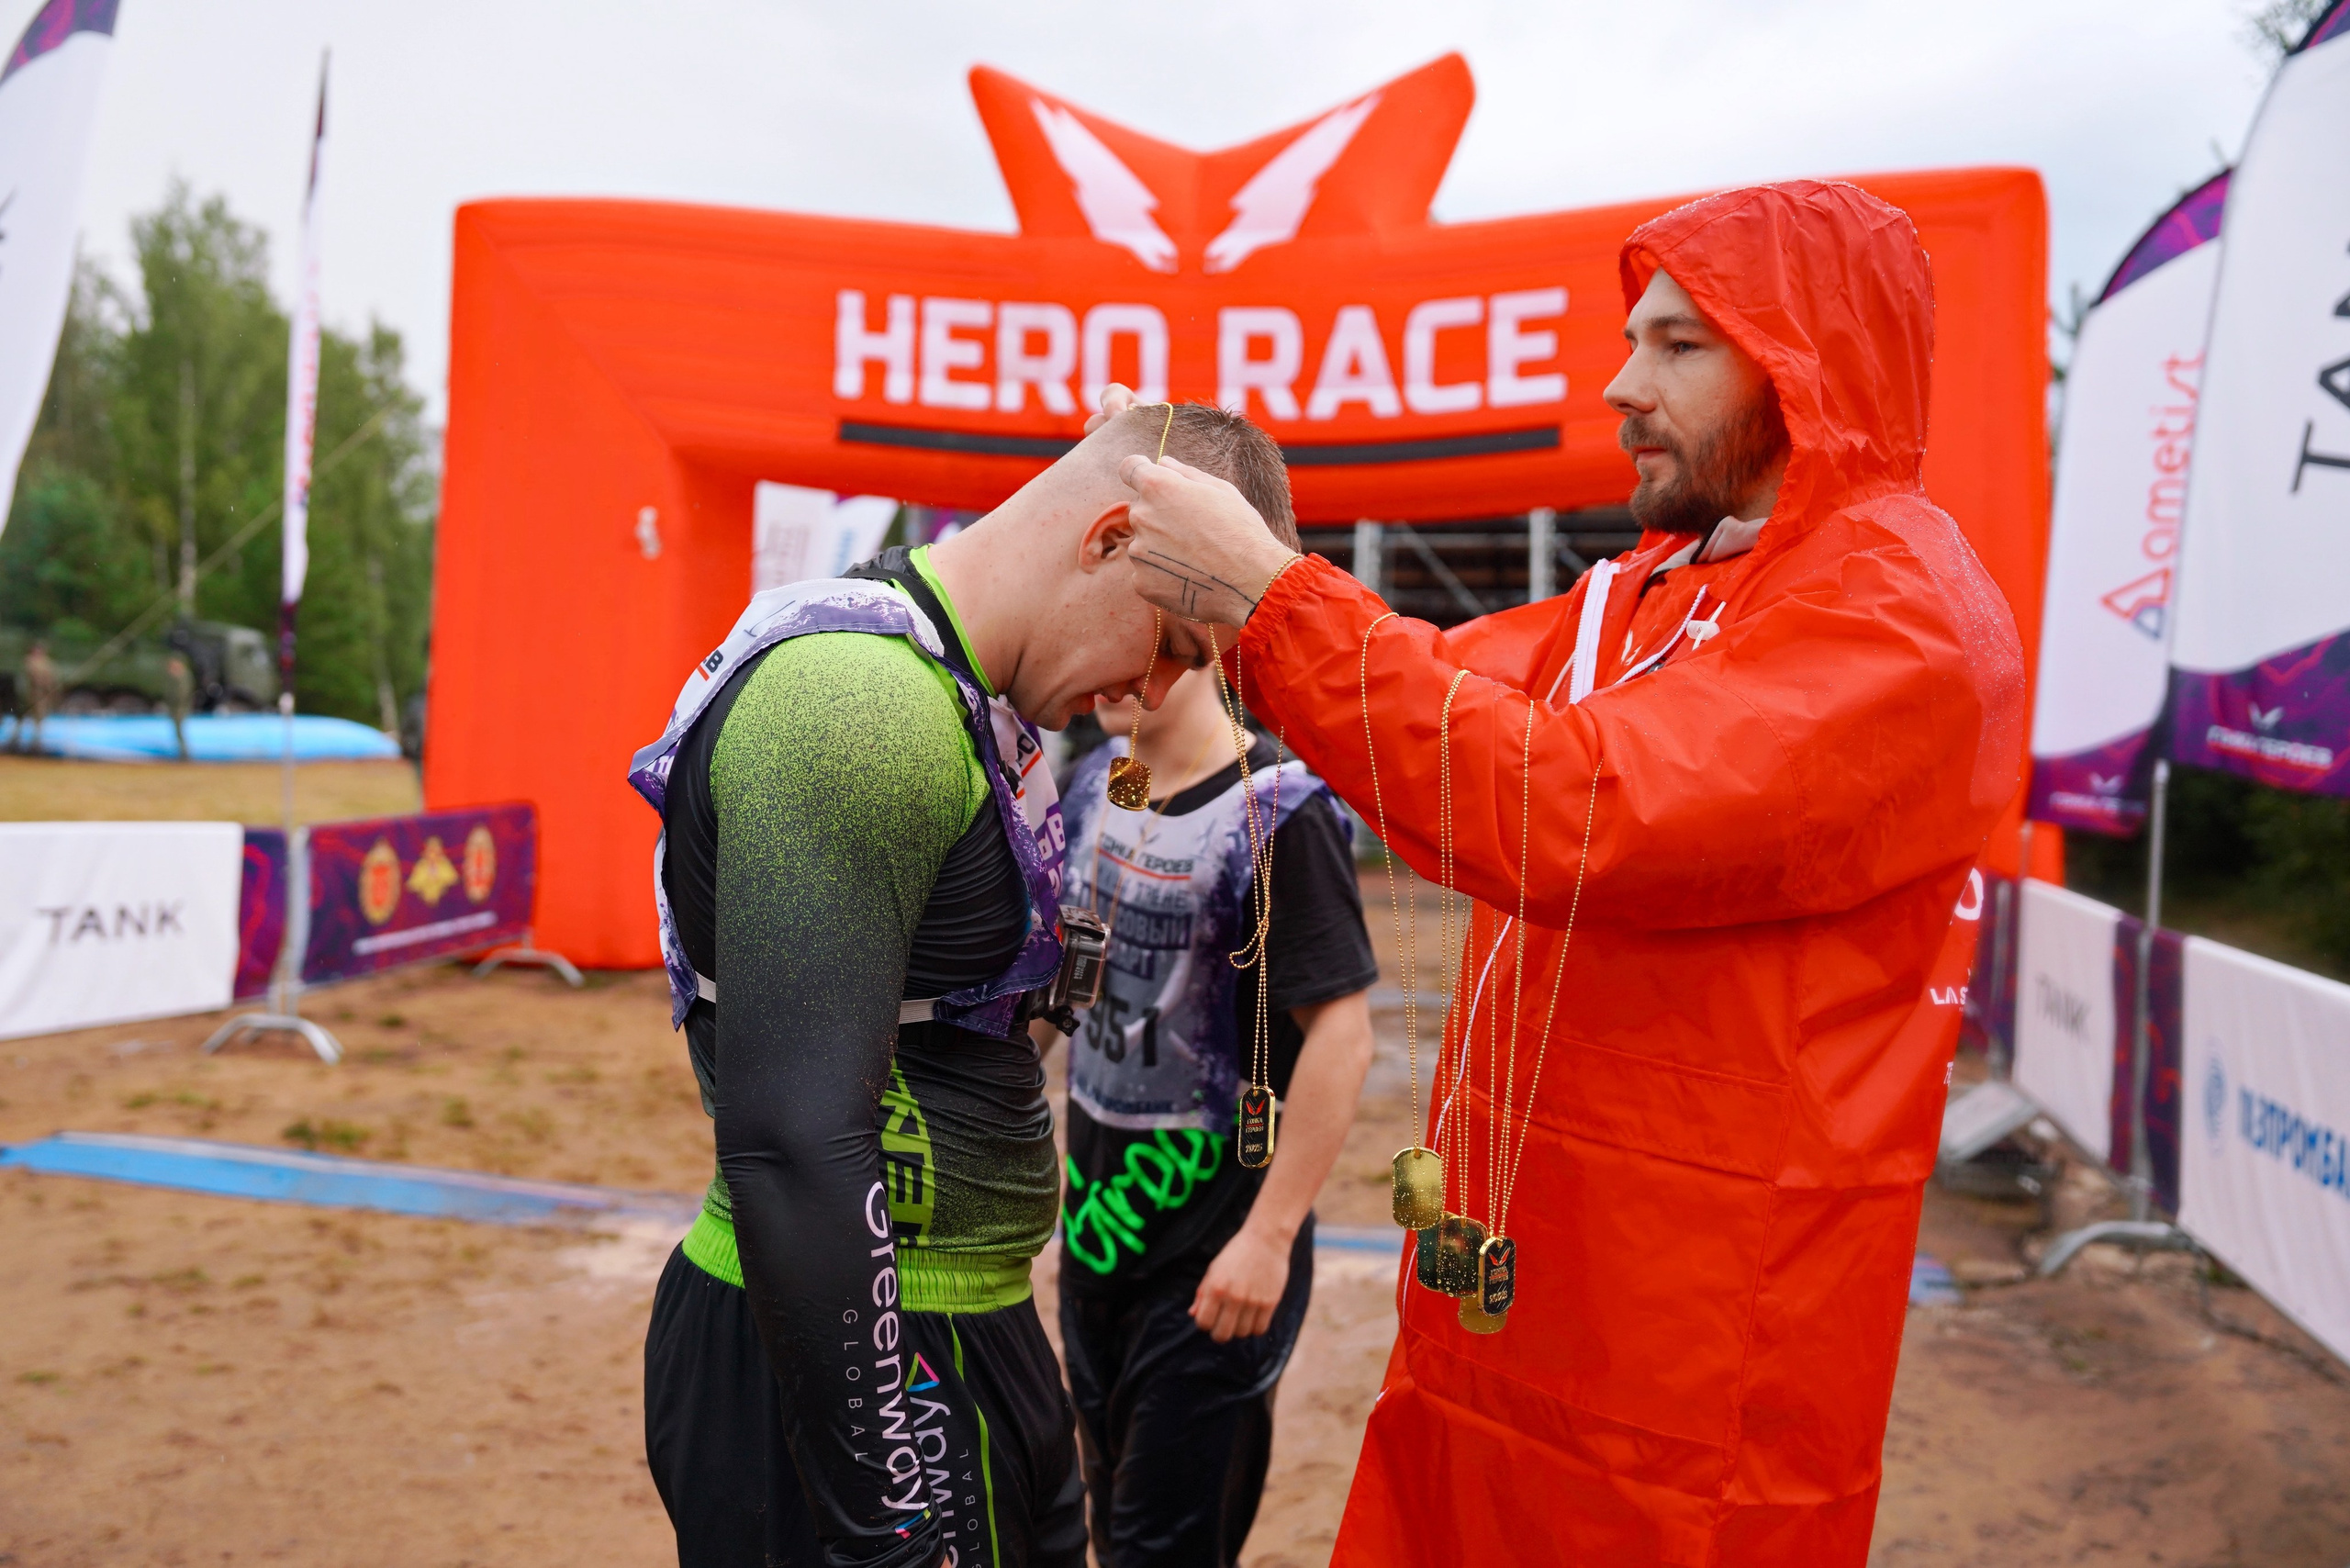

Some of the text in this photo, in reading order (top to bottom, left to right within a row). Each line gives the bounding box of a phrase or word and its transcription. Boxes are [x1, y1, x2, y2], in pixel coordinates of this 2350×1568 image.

[834, 286, 1570, 420] HERO RACE
[35, 900, 185, 949] TANK
[1084, 993, 1161, 1068] 951
[842, 1308, 869, 1462] GLOBAL
[865, 1181, 930, 1511] Greenway
